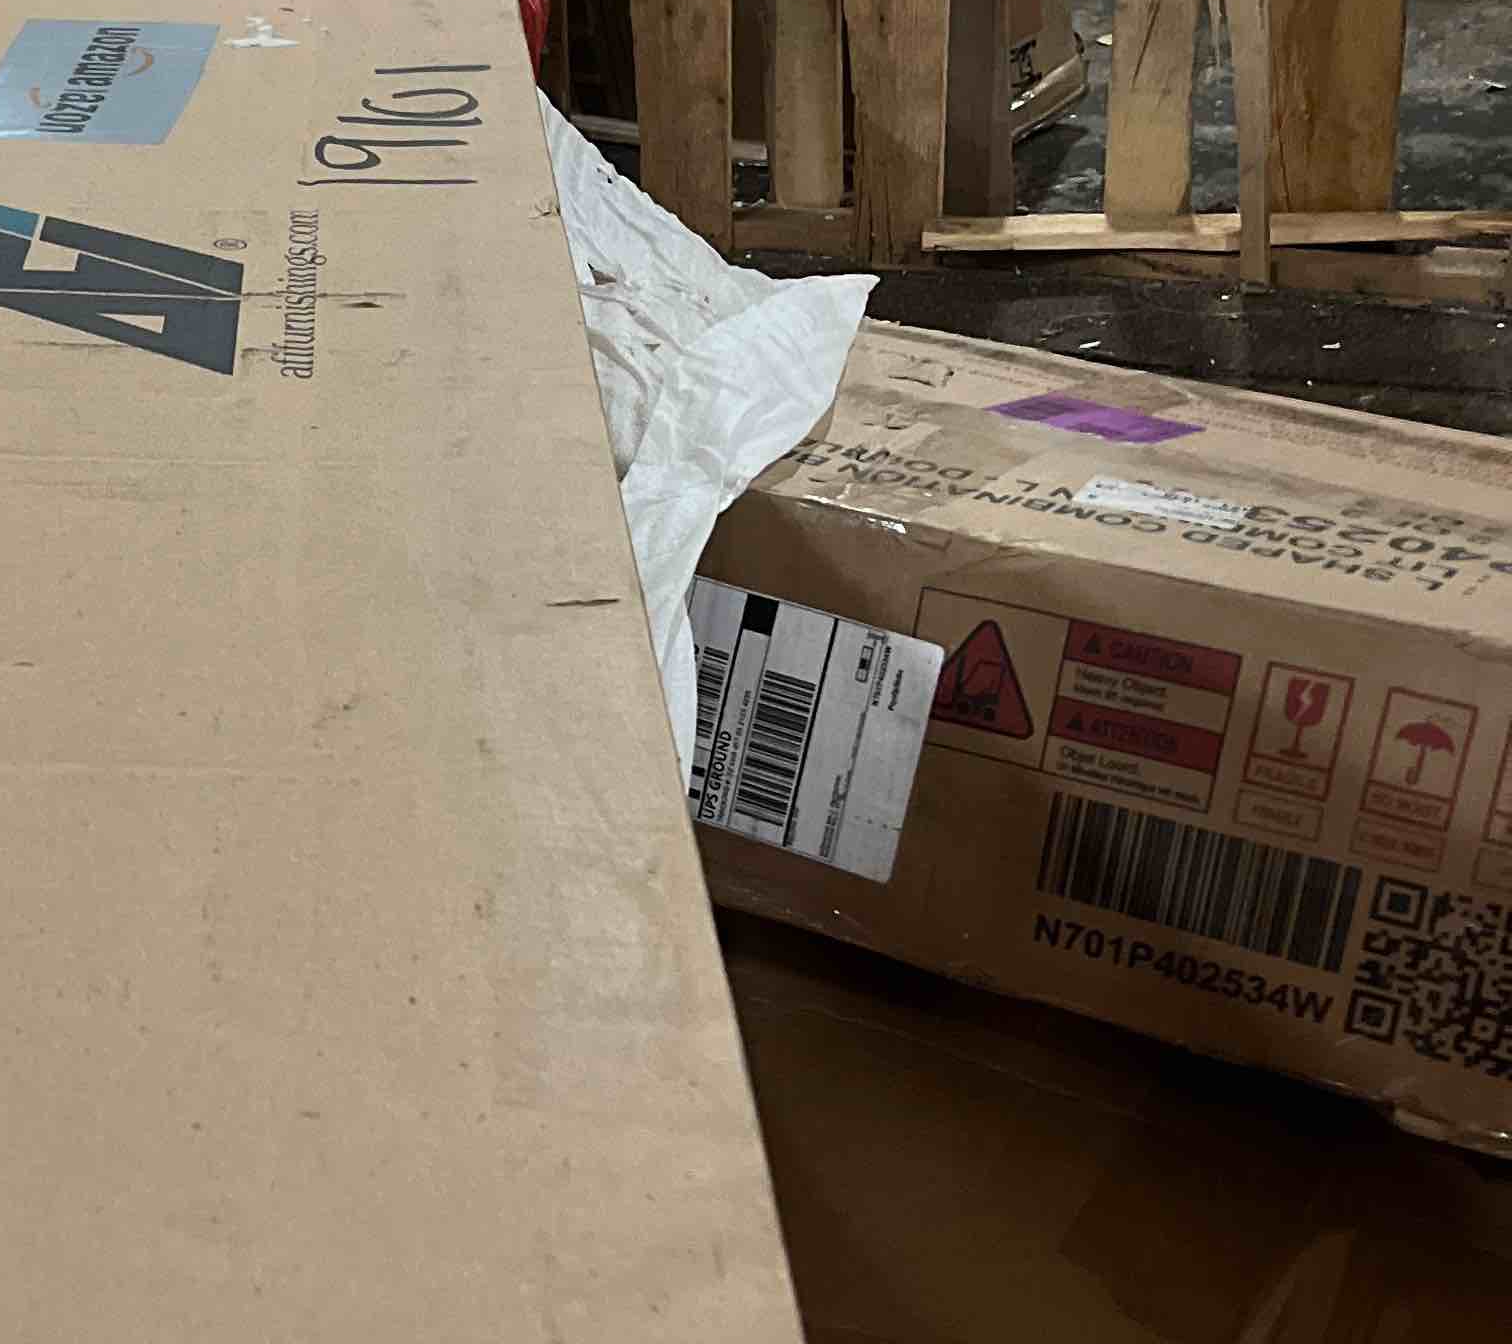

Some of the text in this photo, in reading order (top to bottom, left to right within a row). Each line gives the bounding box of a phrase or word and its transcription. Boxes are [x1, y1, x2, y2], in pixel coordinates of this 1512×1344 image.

[67, 27, 141, 87] amazon
[271, 206, 326, 380] afifurnishings.com
[837, 462, 1168, 535] COMBINATION
[1181, 529, 1396, 582] SHAPED
[701, 730, 732, 820] UPS GROUND
[1032, 913, 1333, 1026] N701P402534W
